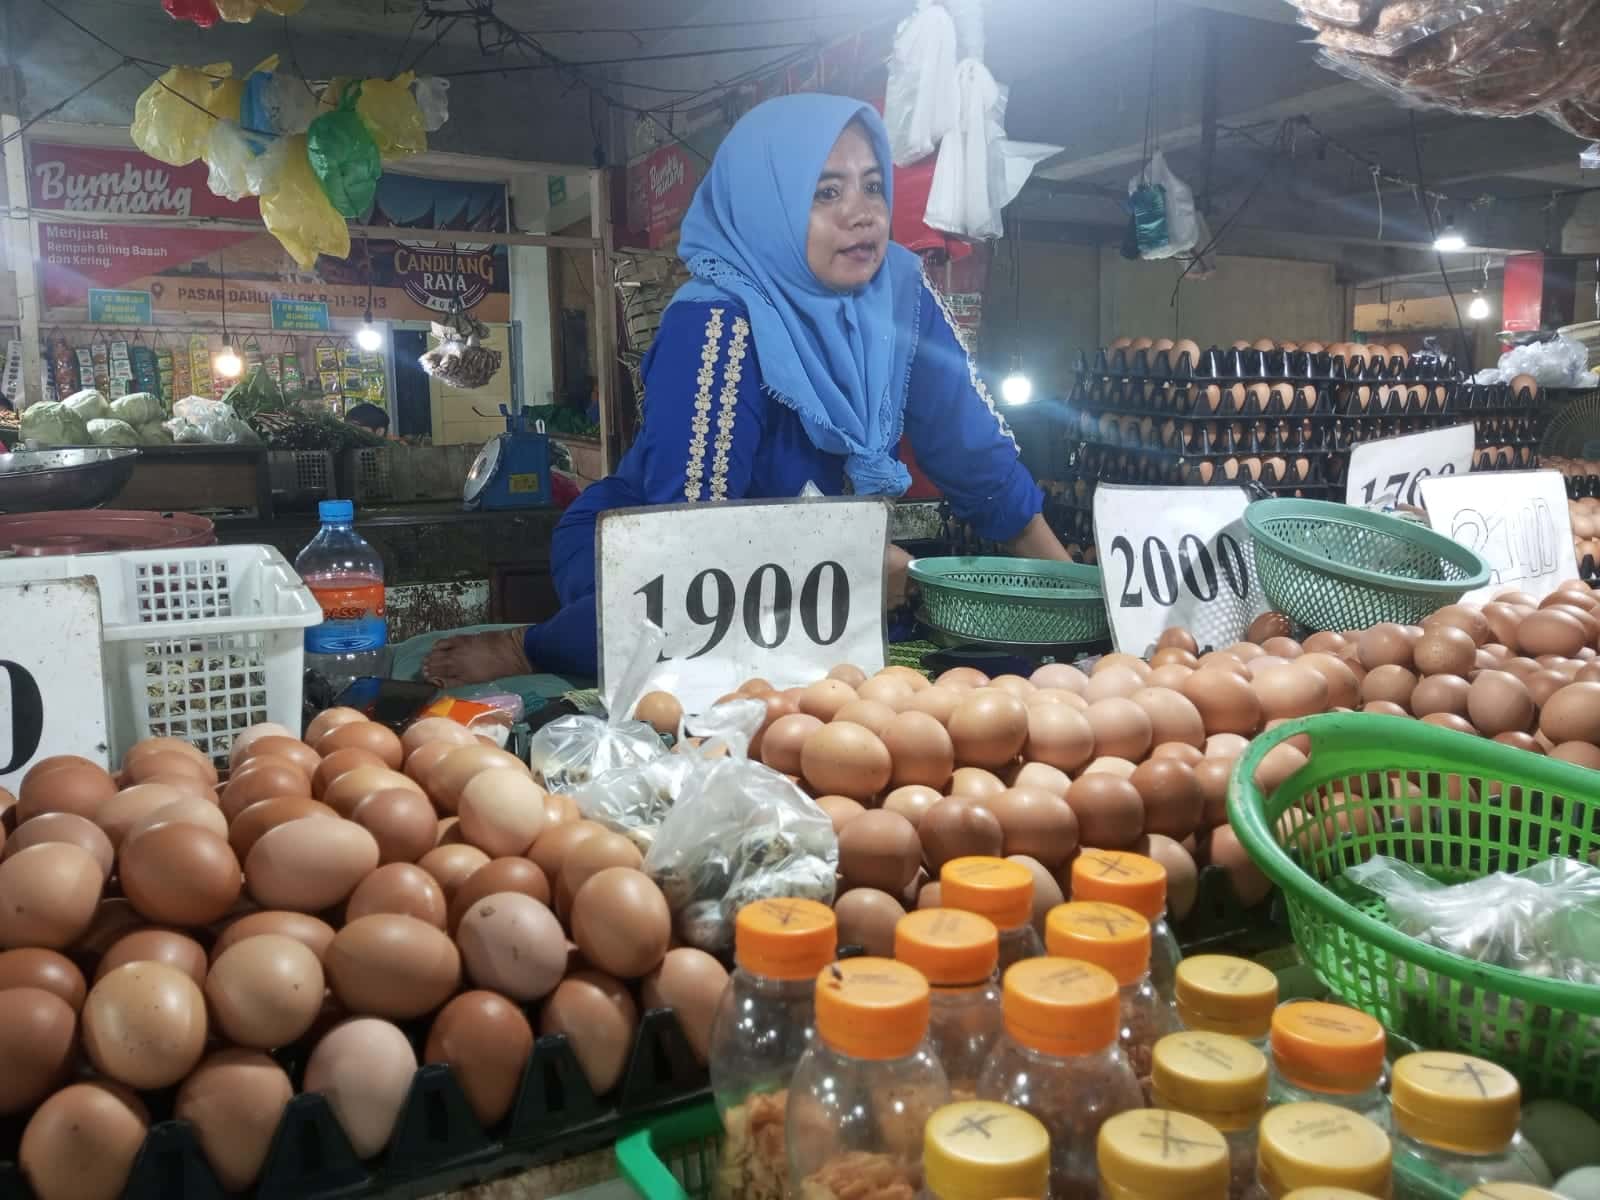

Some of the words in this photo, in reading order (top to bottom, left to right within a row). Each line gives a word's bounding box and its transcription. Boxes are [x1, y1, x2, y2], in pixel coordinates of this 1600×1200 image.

[36, 160, 169, 200] Bumbu
[46, 225, 109, 240] Menjual:
[47, 242, 97, 255] Rempah
[97, 244, 130, 257] Giling
[47, 254, 71, 265] dan
[394, 248, 493, 285] CANDUANG
[178, 287, 224, 300] PASAR
[423, 272, 468, 292] RAYA
[1361, 463, 1455, 510] 170
[1111, 532, 1249, 608] 2000
[633, 560, 850, 663] 1900
